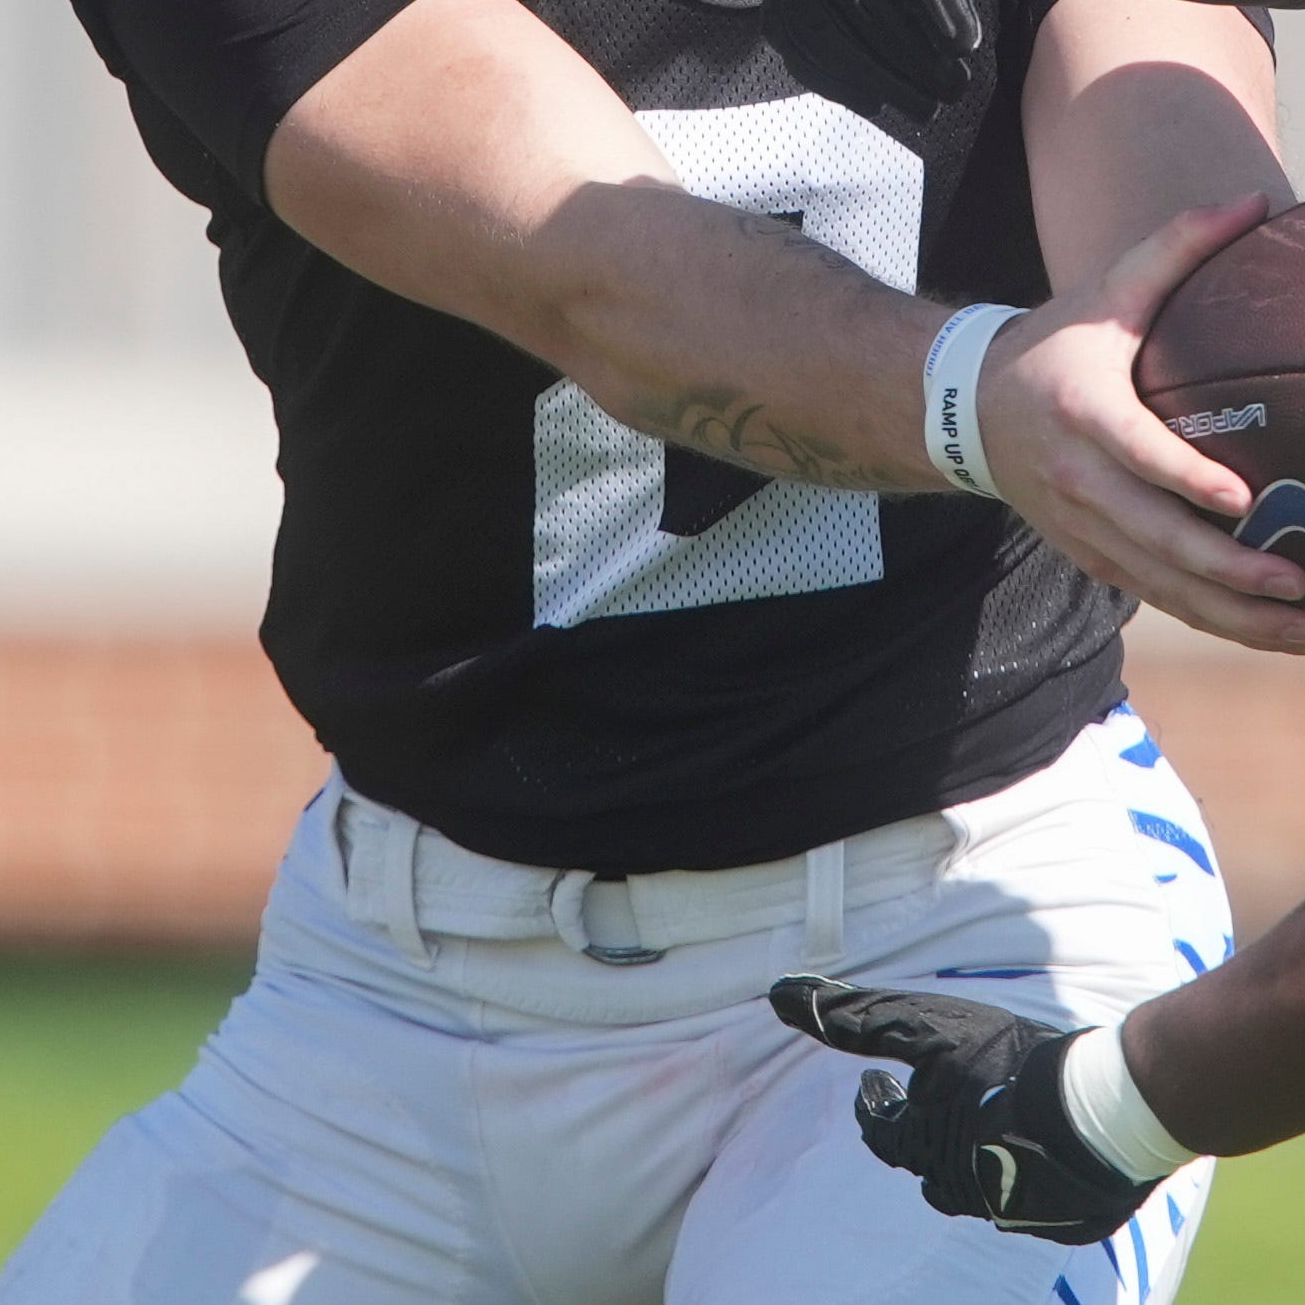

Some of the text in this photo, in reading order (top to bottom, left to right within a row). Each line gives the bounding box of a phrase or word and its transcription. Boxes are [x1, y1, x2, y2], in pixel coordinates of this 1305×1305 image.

[925, 335, 946, 378] TOUGH
[945, 316, 964, 333] ALL
[941, 388, 958, 438] RAMP
[1179, 403, 1267, 439] VAPOR
[944, 443, 964, 465] UP
